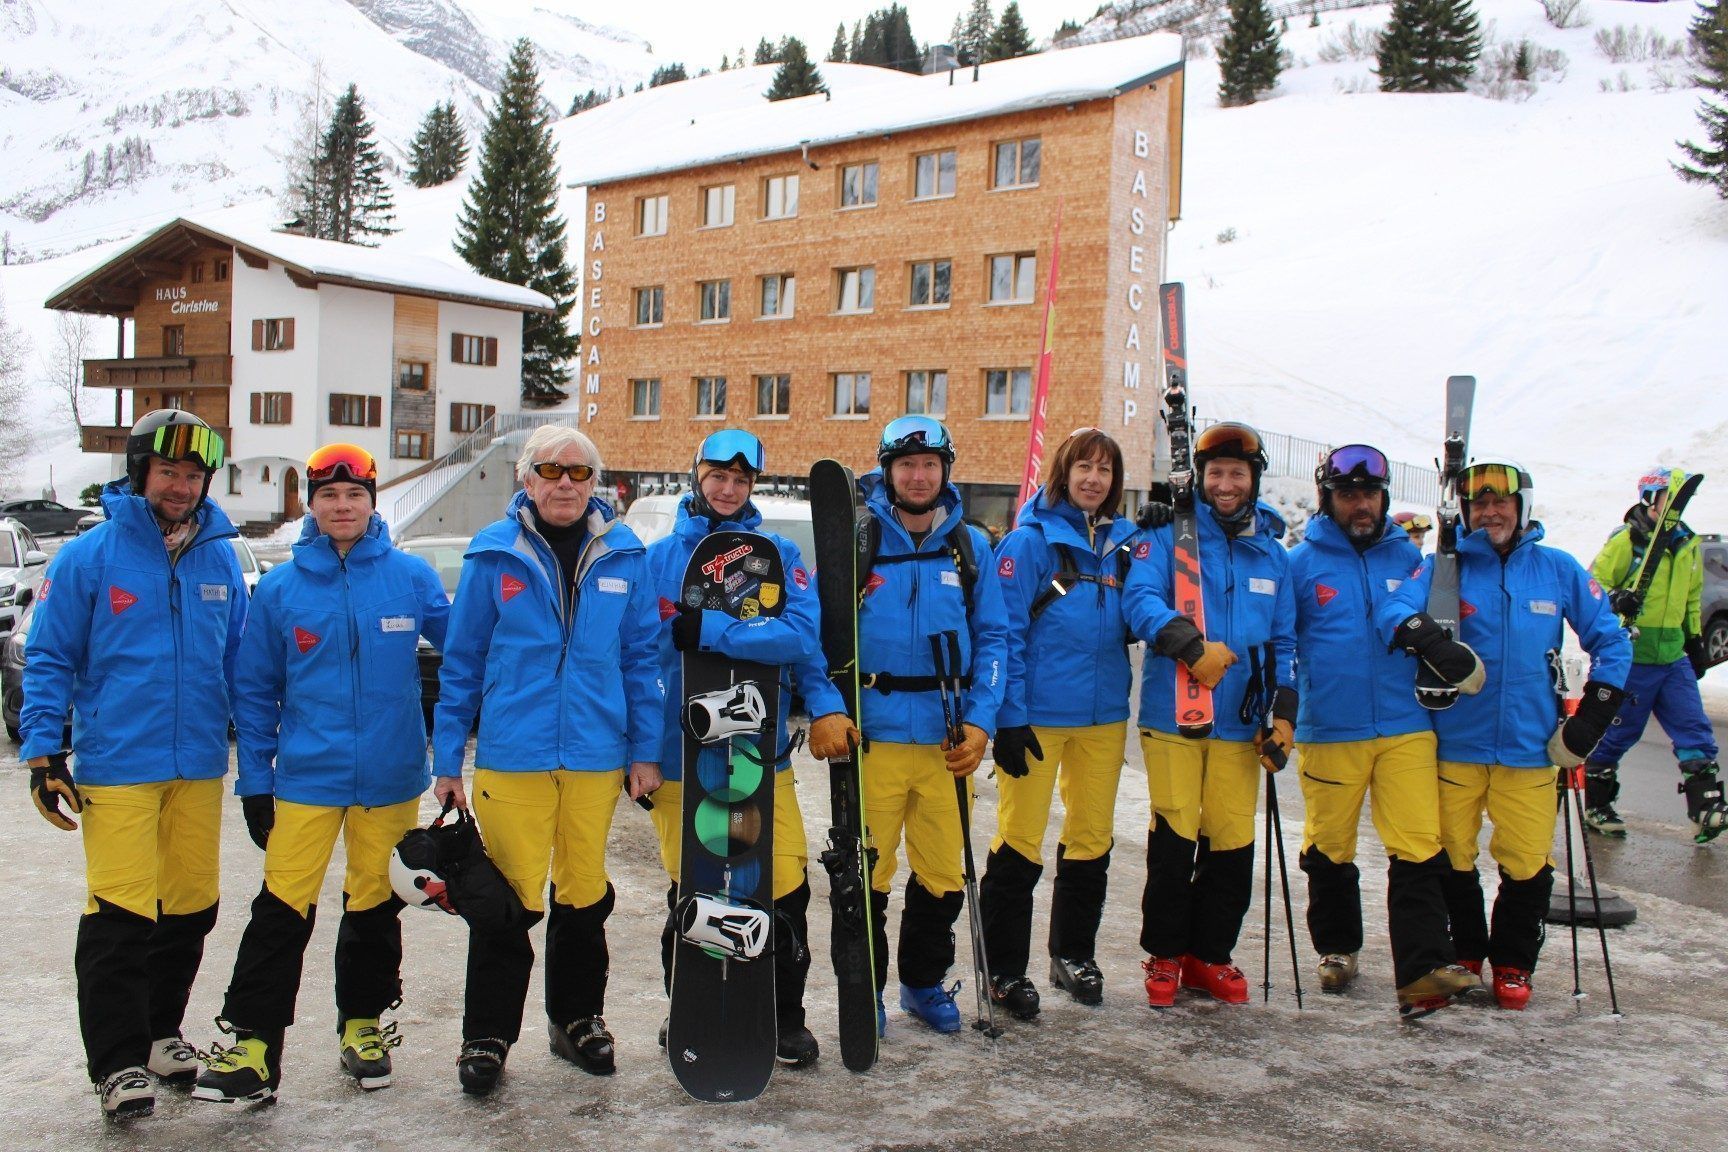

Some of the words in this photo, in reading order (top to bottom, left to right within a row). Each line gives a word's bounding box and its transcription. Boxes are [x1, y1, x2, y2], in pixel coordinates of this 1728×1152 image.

[155, 287, 187, 300] HAUS
[171, 299, 219, 314] Christine
[586, 201, 606, 424] BASECAMP
[1123, 130, 1149, 427] BASECAMP
